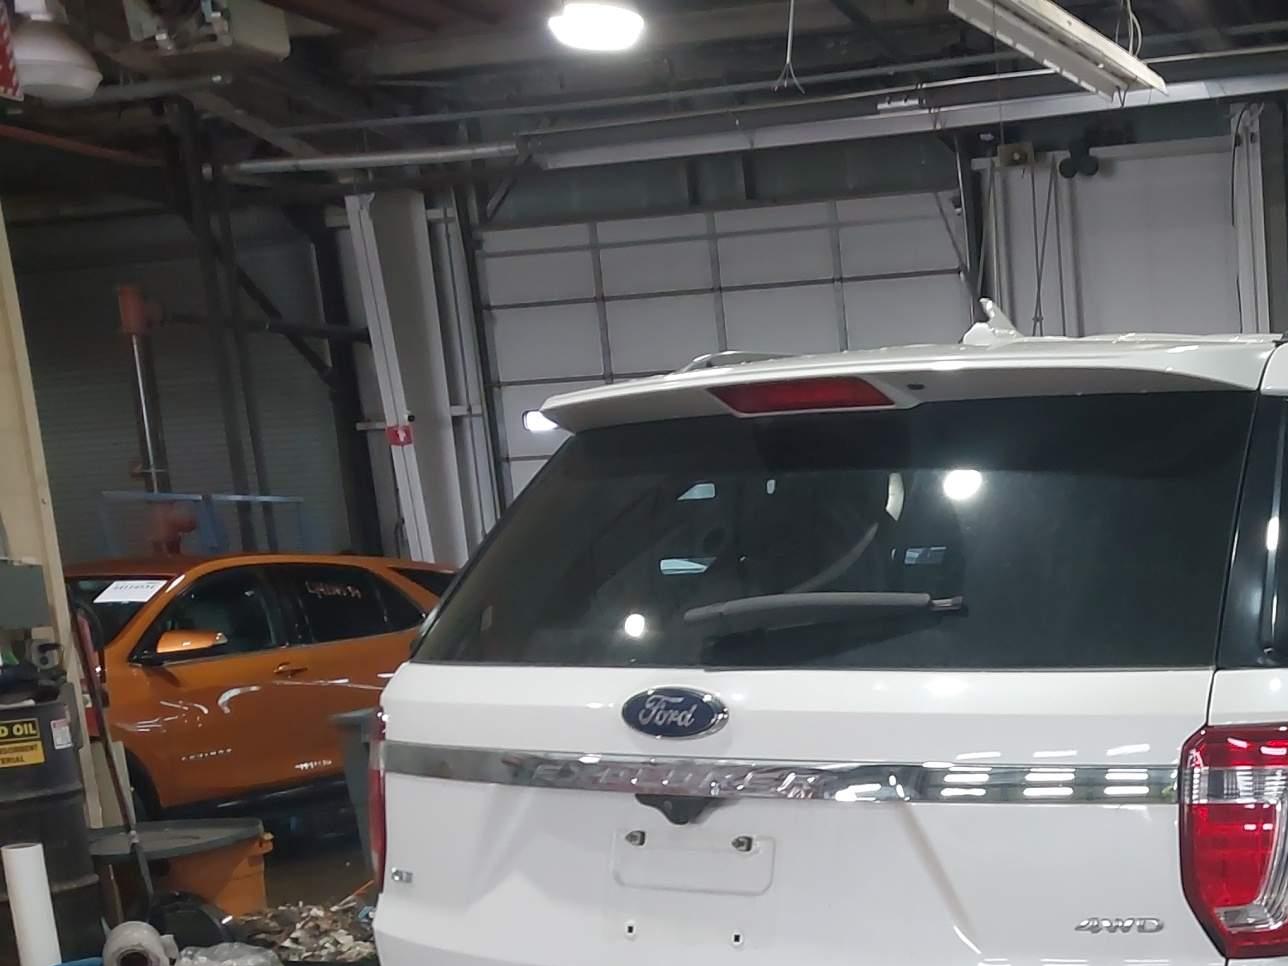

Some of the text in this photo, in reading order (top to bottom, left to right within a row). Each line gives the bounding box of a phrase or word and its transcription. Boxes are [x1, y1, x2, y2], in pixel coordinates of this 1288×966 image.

[638, 694, 698, 727] Ford
[12, 722, 37, 736] OIL
[1074, 917, 1164, 933] 4WD
